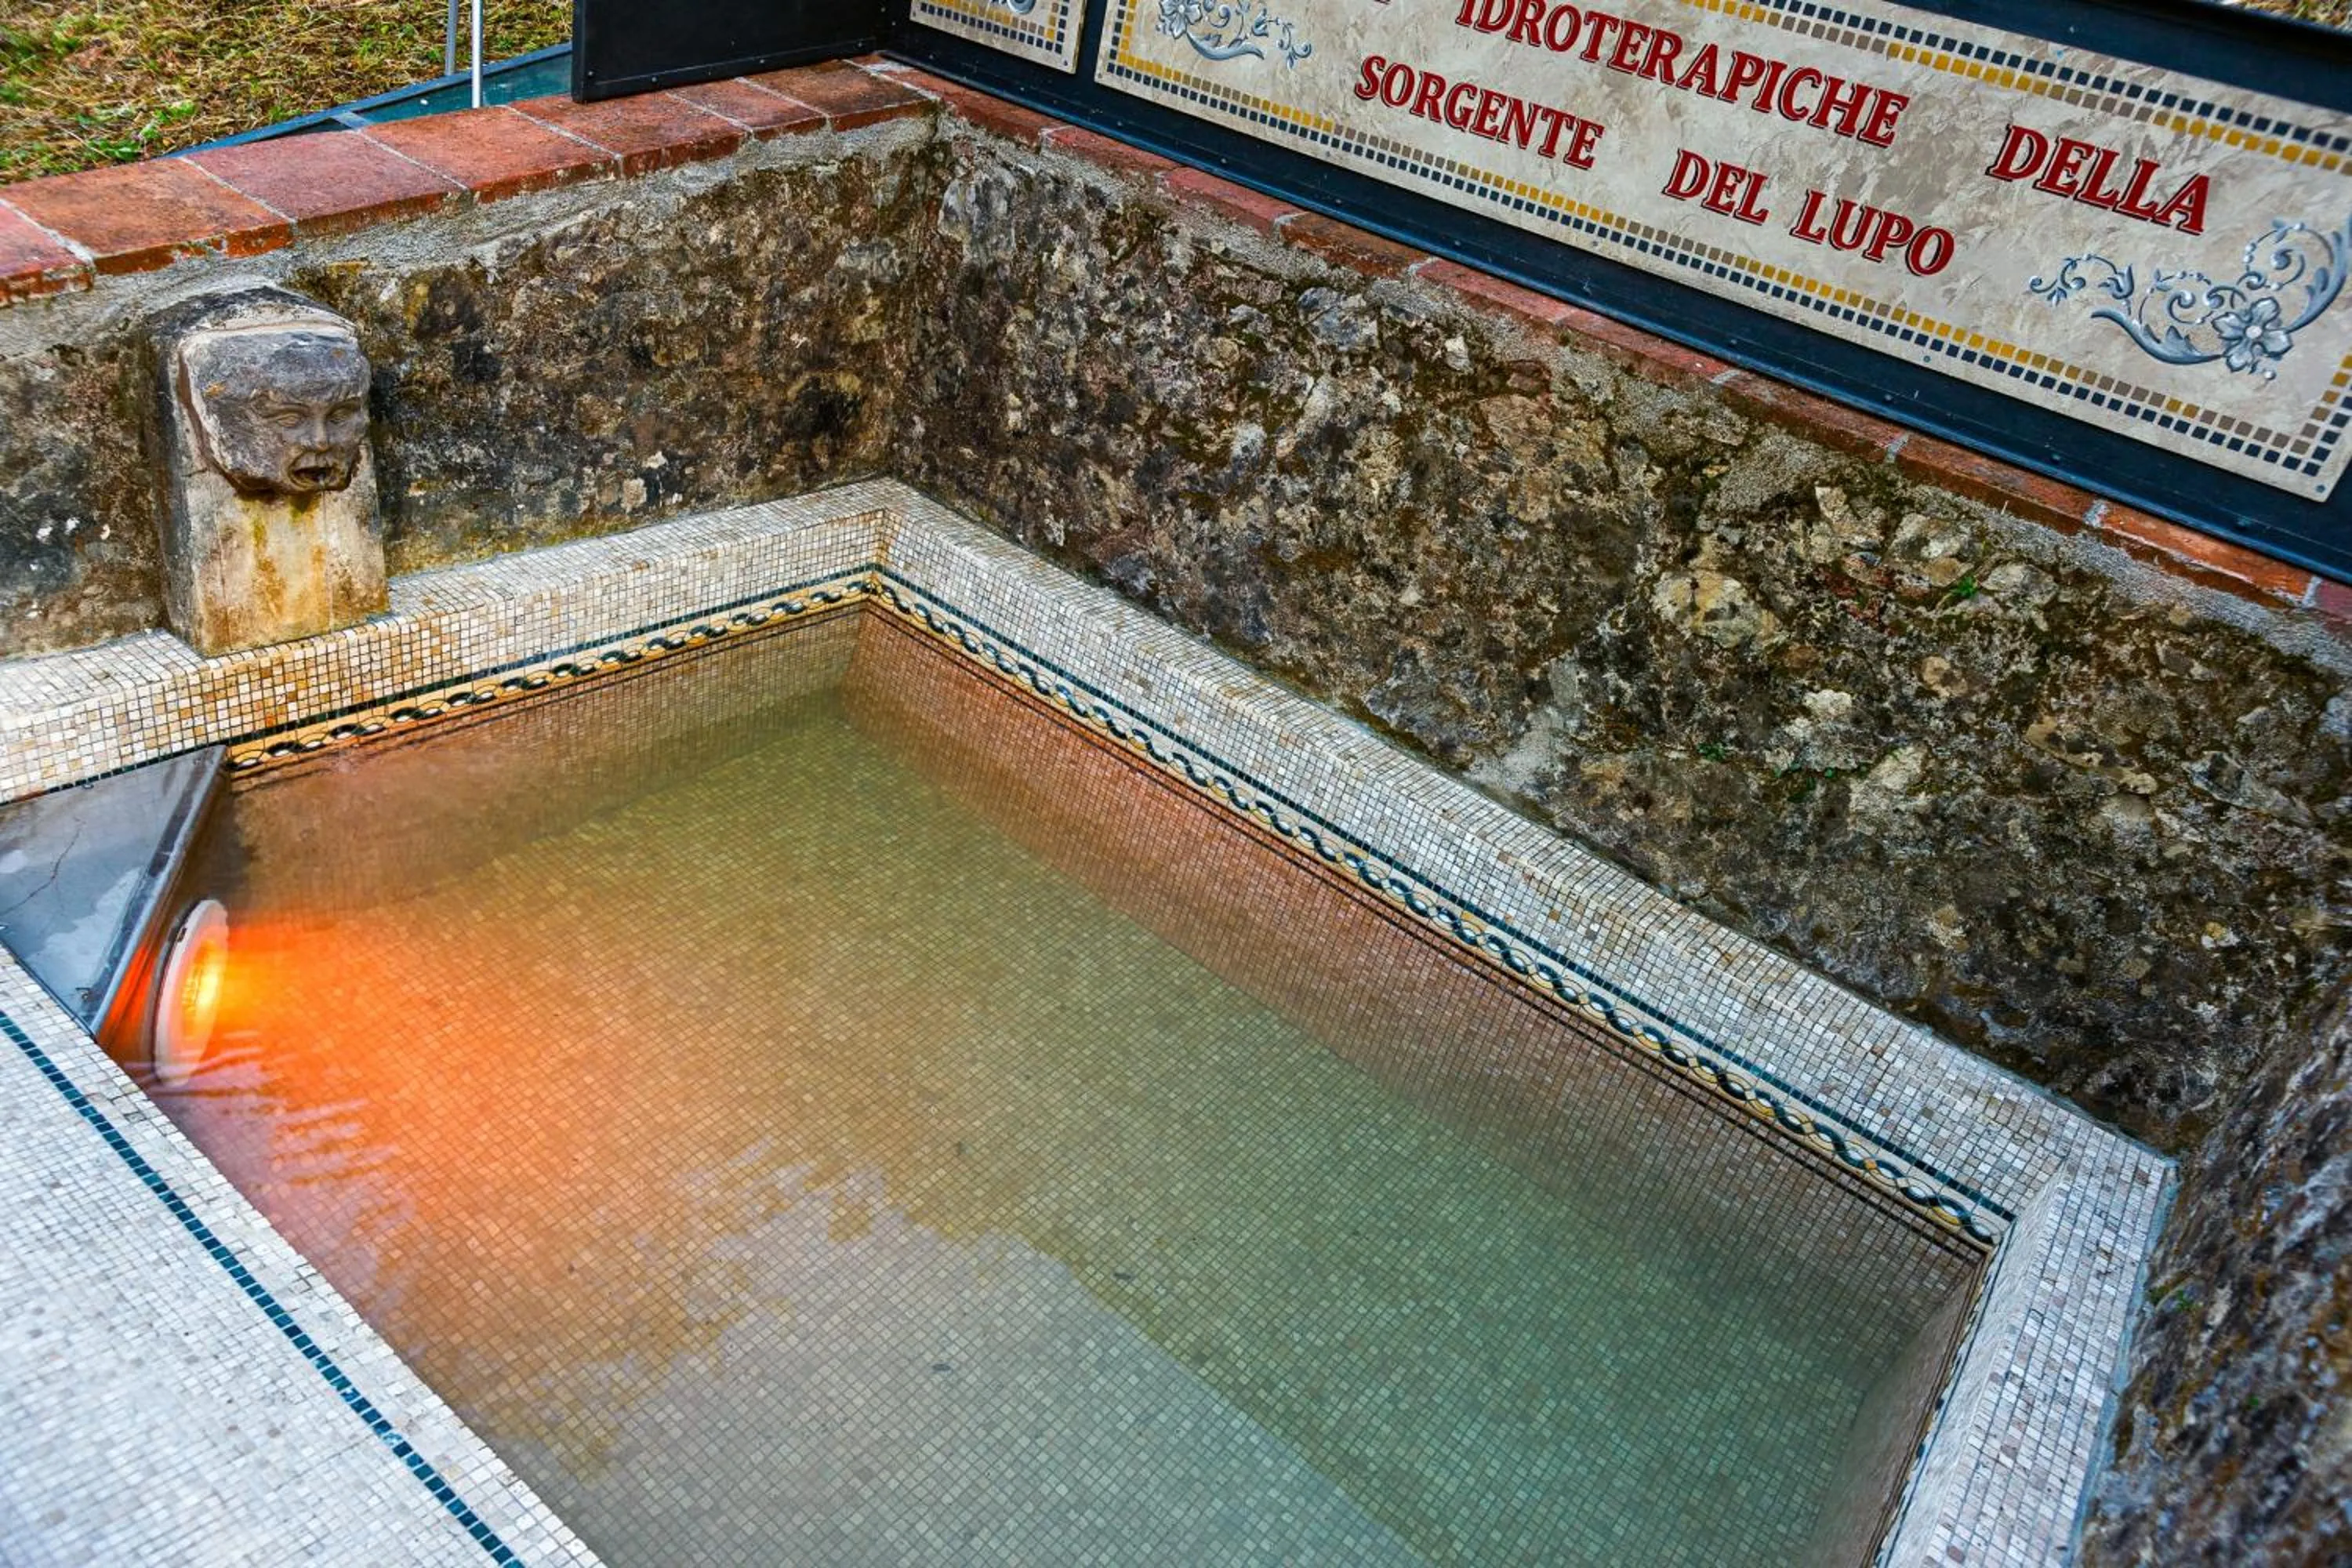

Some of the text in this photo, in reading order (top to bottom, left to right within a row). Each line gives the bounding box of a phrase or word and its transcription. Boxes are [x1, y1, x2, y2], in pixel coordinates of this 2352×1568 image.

[1354, 54, 1956, 277] SORGENTE DEL LUPO
[1987, 124, 2209, 234] DELLA
